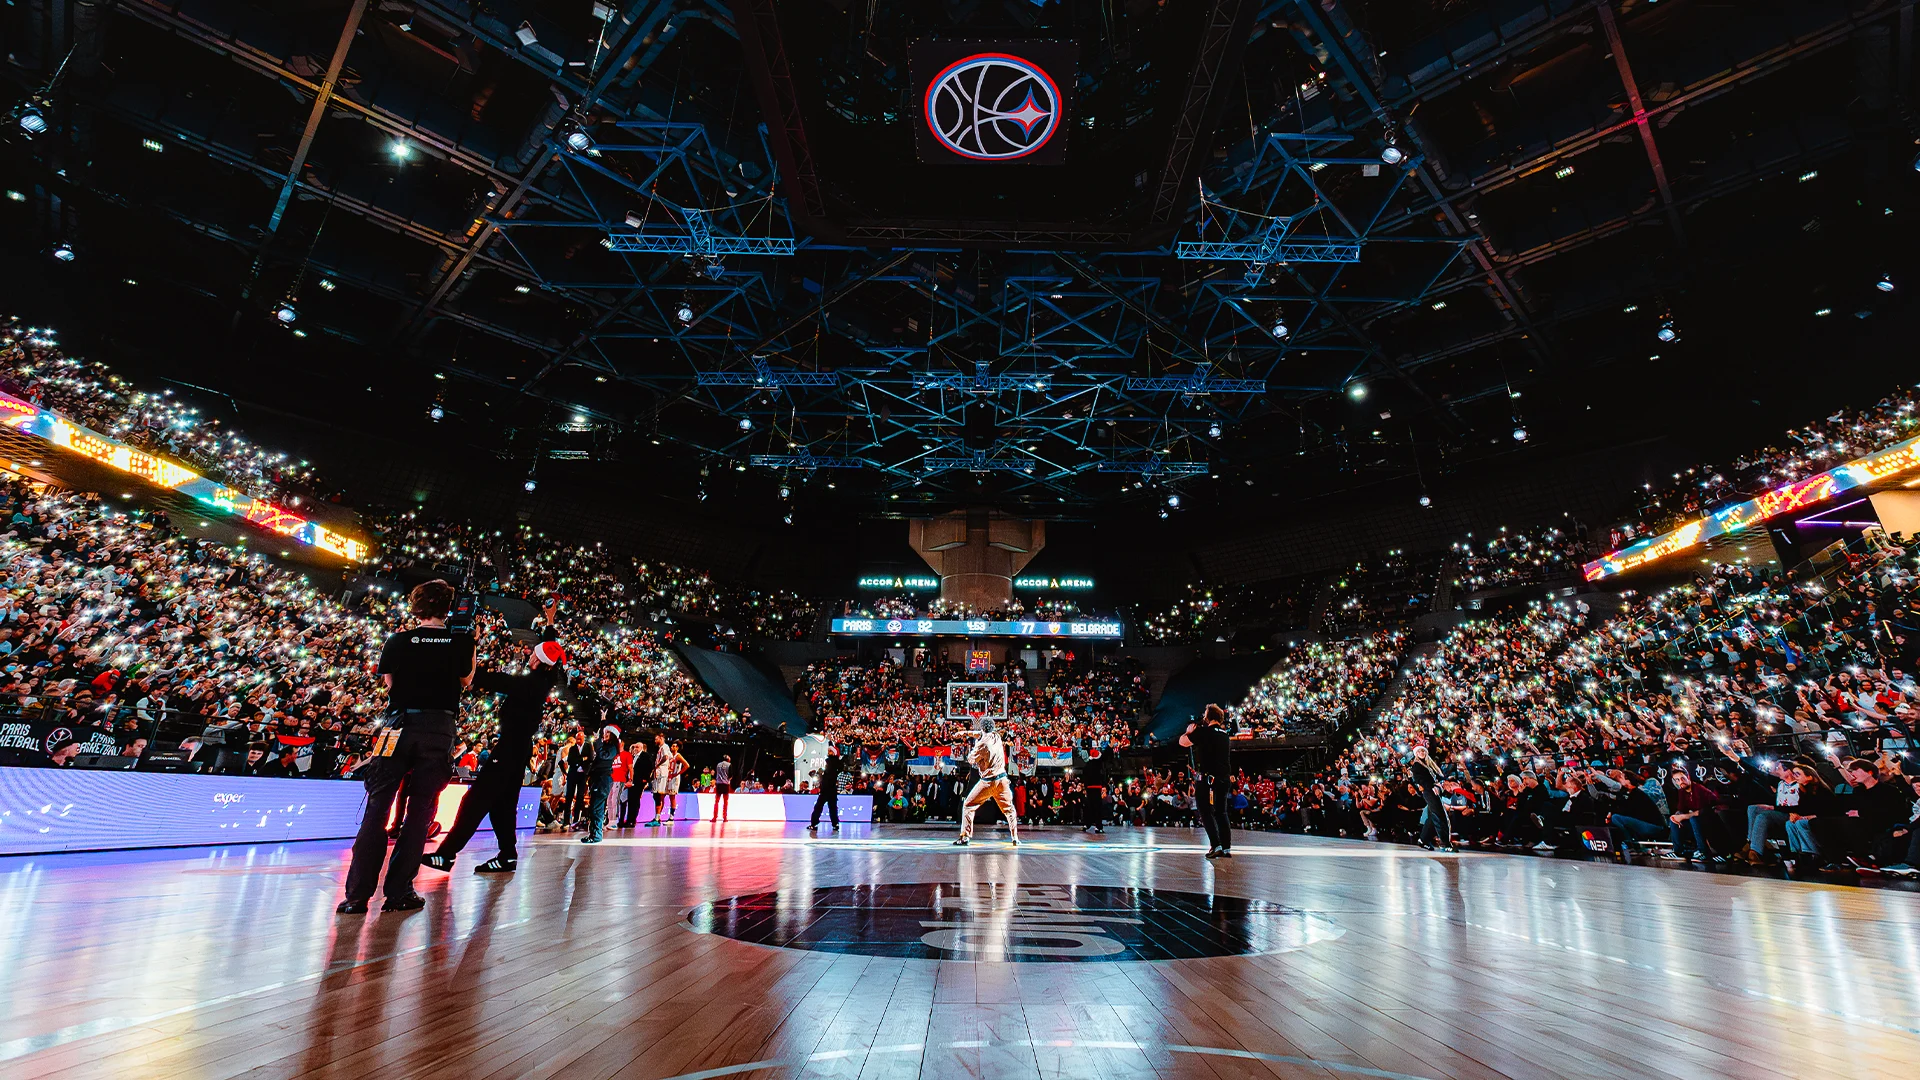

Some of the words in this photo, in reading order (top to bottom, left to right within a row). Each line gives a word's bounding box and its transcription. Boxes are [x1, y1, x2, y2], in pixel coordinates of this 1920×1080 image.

[859, 578, 893, 586] ACCOR
[904, 578, 937, 587] ARENA
[1016, 579, 1049, 587] ACCOR
[1060, 579, 1093, 587] ARENA
[843, 620, 872, 631] PARIS
[1021, 622, 1035, 634] 77
[1071, 622, 1119, 635] BELGRADE
[970, 658, 985, 669] 24
[0, 723, 31, 736] PARIS
[0, 735, 40, 752] KETBALL
[810, 757, 826, 768] PARI
[1589, 839, 1608, 852] NEP
